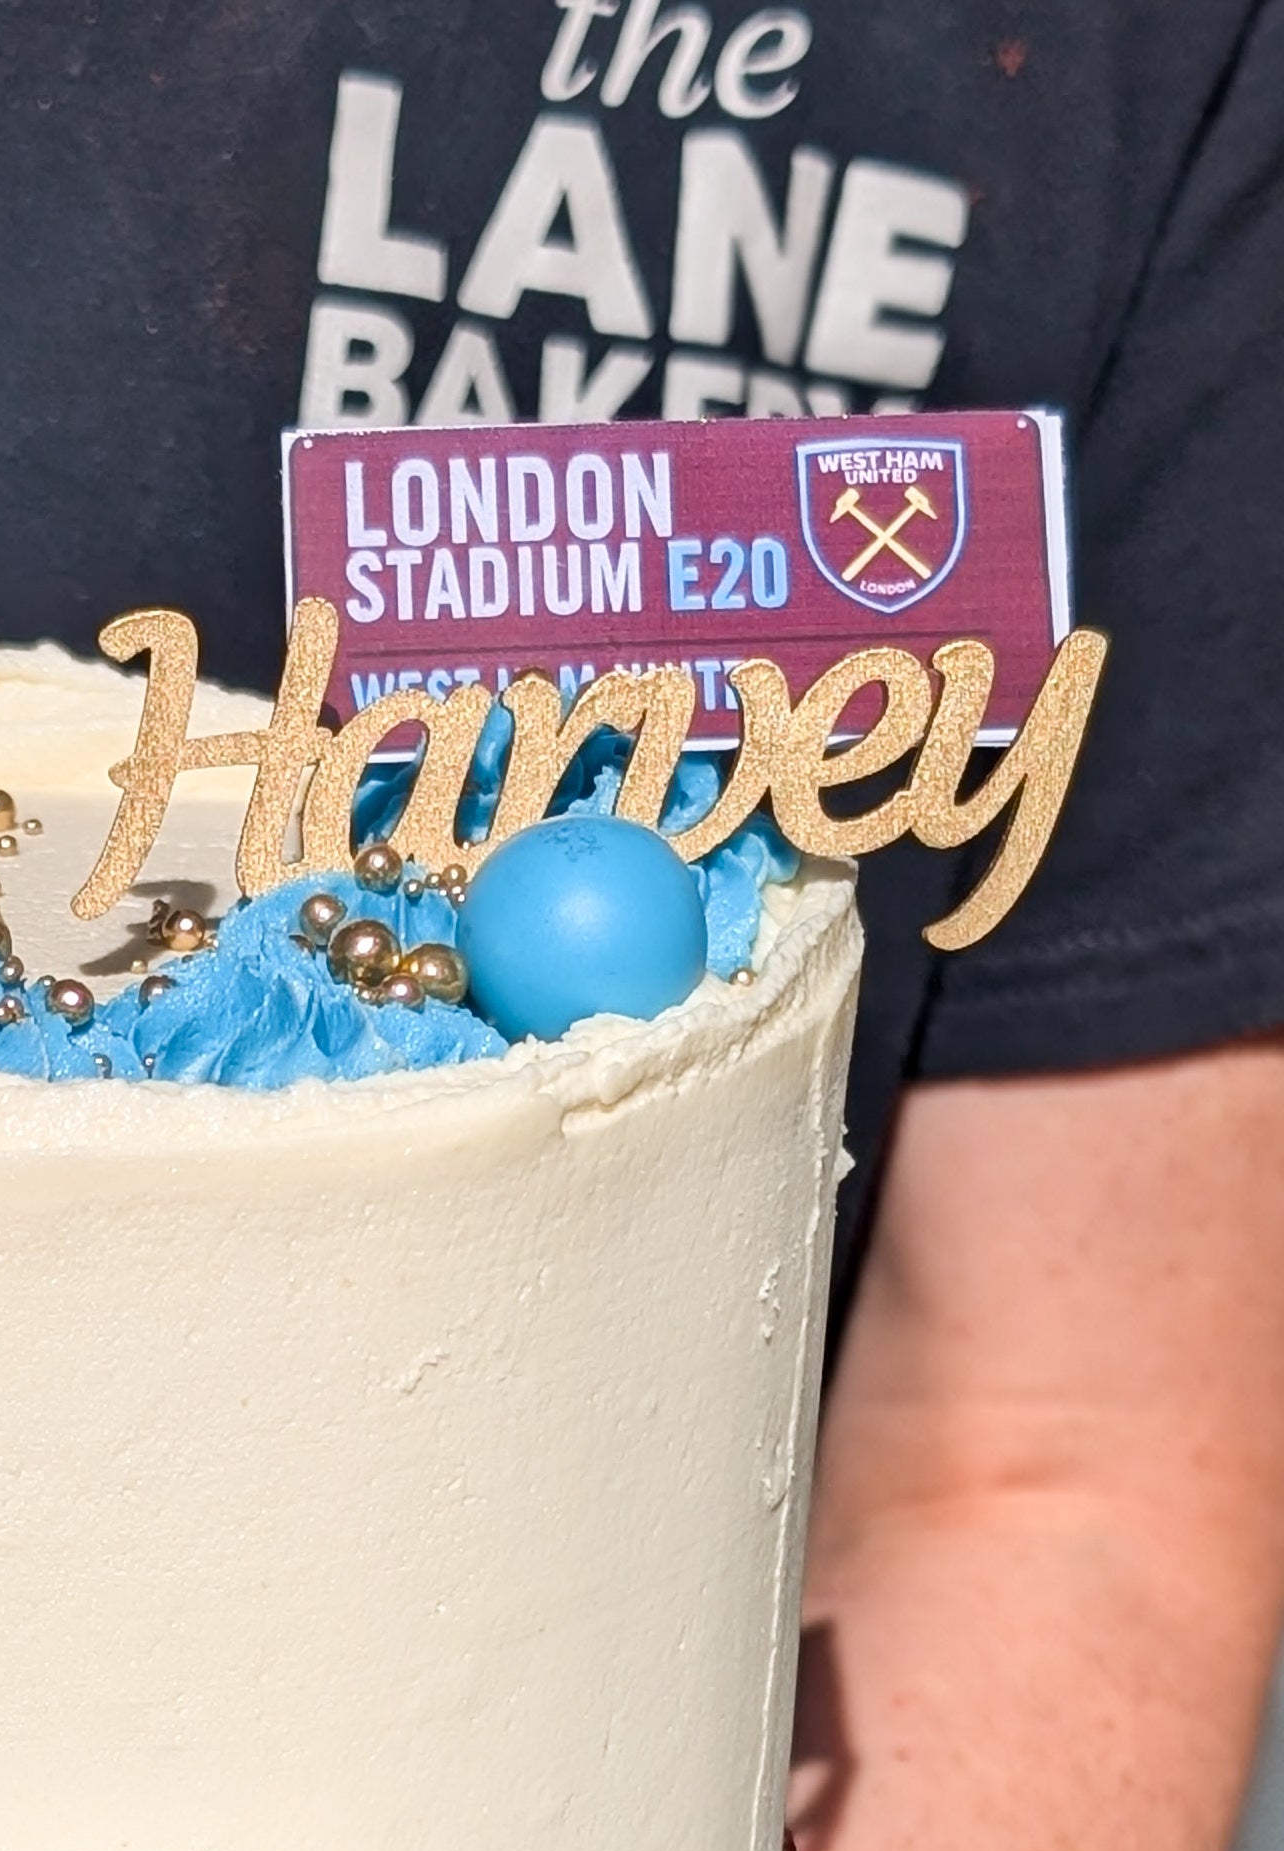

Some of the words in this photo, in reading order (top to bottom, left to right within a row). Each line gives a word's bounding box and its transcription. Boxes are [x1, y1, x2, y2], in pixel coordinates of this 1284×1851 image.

[542, 0, 813, 119] the
[319, 70, 970, 389] LANE
[298, 299, 922, 427] BAKE
[344, 452, 673, 548] LONDON
[817, 450, 881, 474] WEST
[885, 450, 944, 471] HAM
[844, 468, 918, 485] UNITED
[345, 541, 643, 623] STADIUM
[667, 537, 788, 612] E20
[859, 578, 917, 596] LONDON
[71, 596, 1109, 952] Harvey
